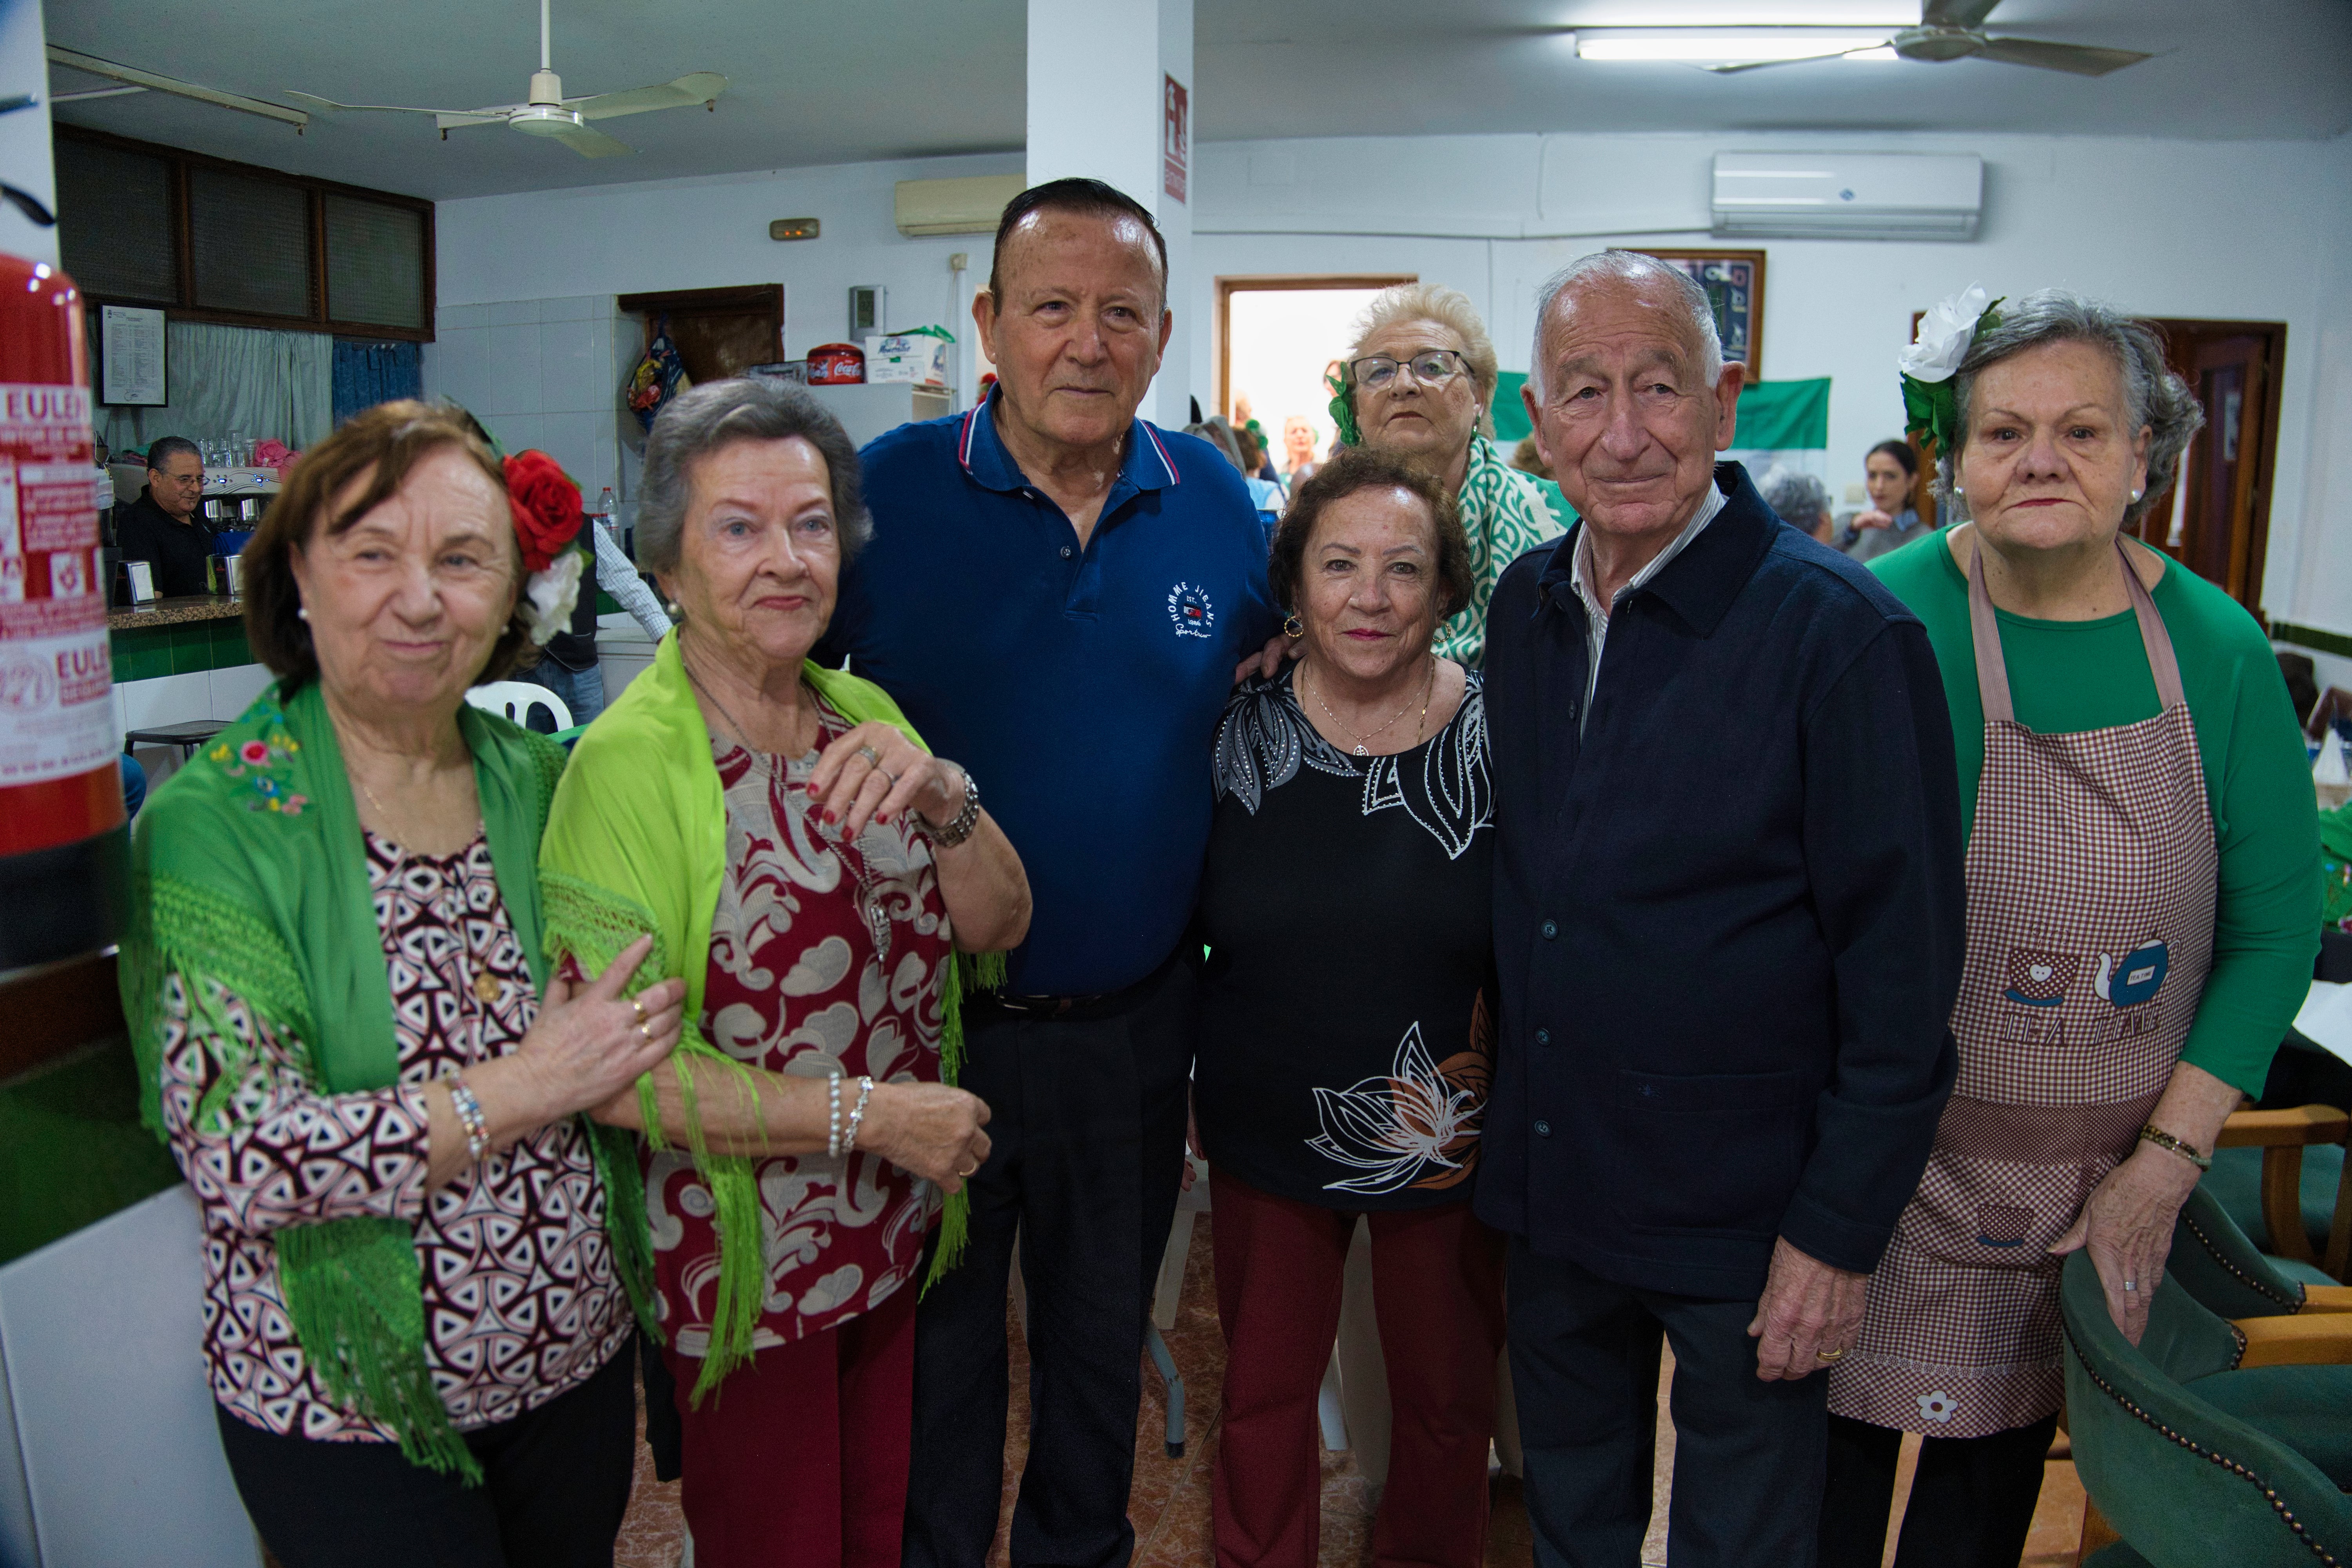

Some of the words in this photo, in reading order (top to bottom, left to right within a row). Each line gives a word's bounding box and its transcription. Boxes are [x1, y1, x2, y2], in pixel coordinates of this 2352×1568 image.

[1168, 582, 1188, 622] HOMME
[1186, 595, 1197, 604] EST.
[2000, 1011, 2069, 1047] TEA
